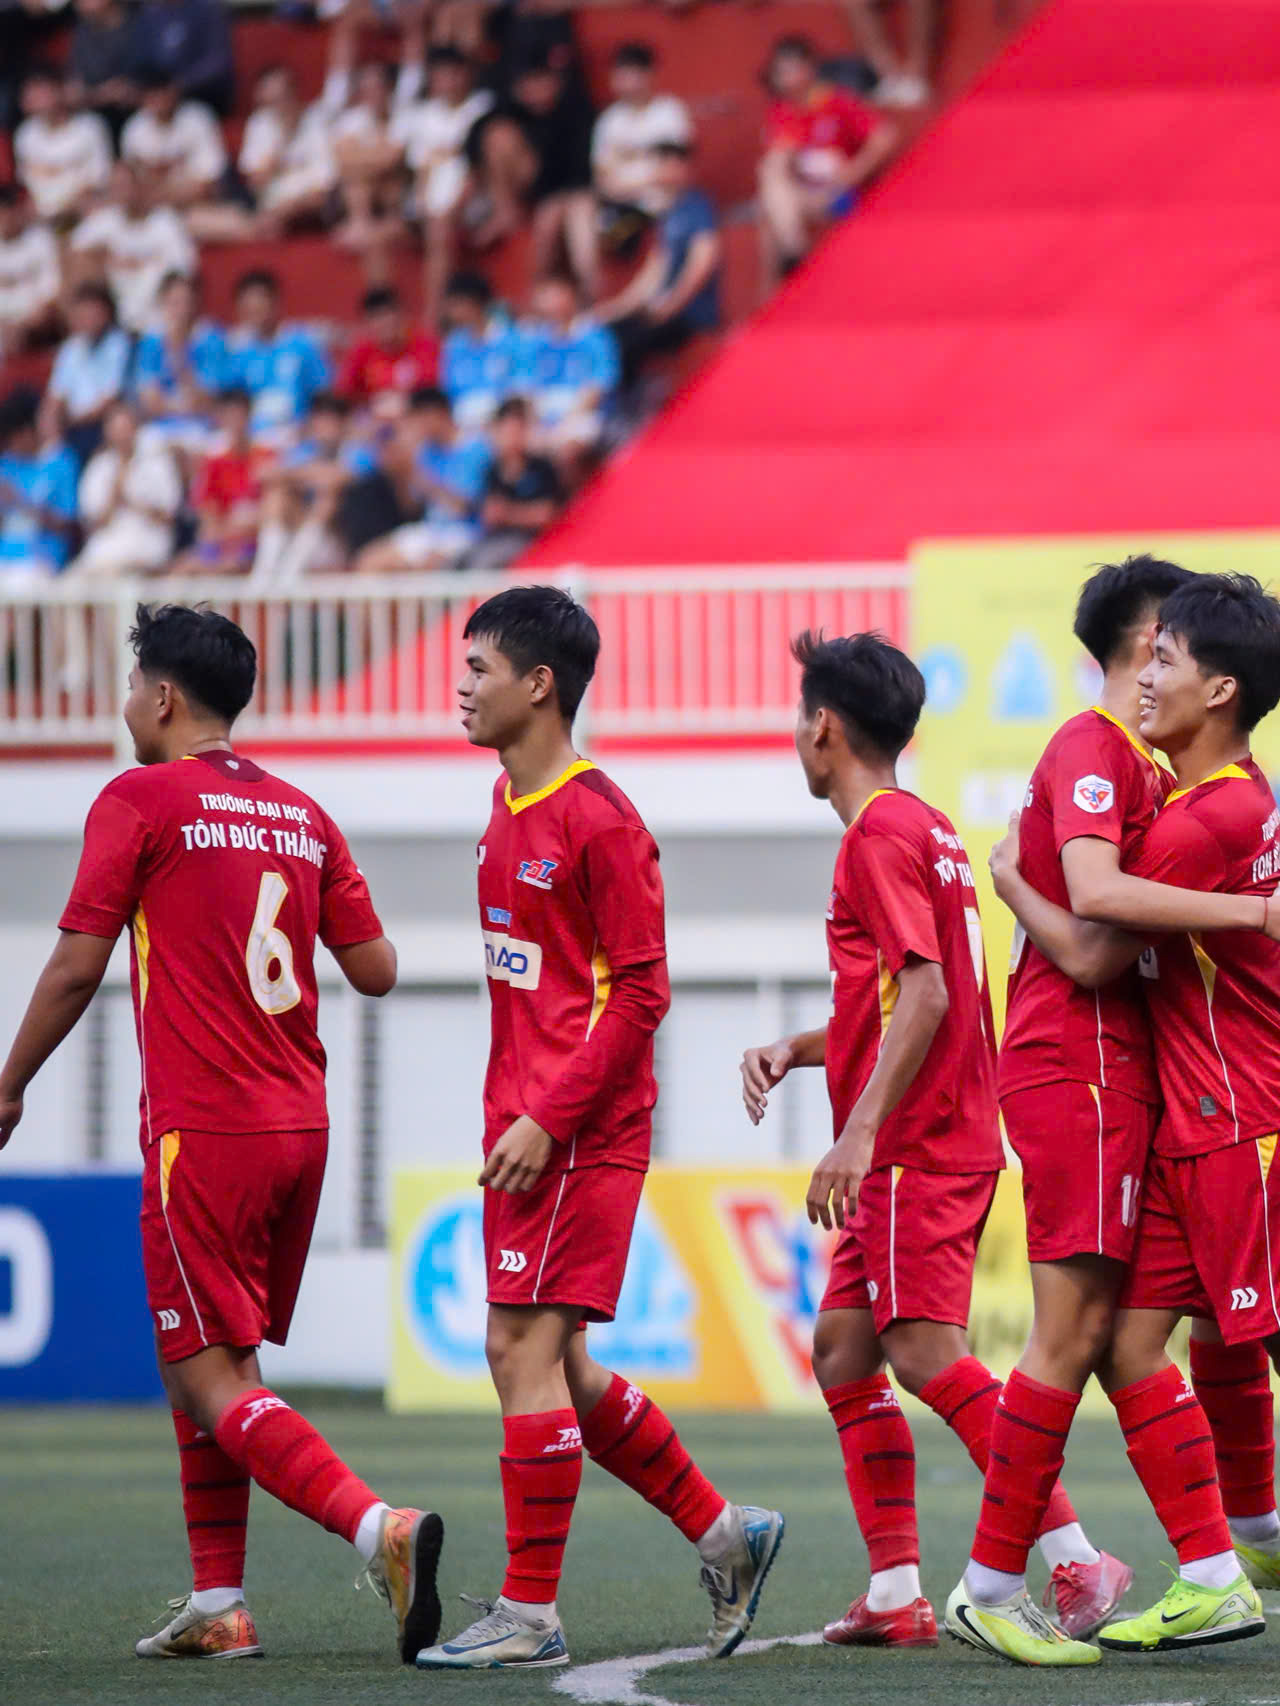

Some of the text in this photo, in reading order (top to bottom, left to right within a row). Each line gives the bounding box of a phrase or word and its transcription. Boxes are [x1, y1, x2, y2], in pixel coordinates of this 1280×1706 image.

[199, 793, 311, 825] TRƯỜNG ĐẠI HỌC
[181, 818, 327, 869] TÔN ĐỨC THẮNG
[246, 872, 301, 1015] 6
